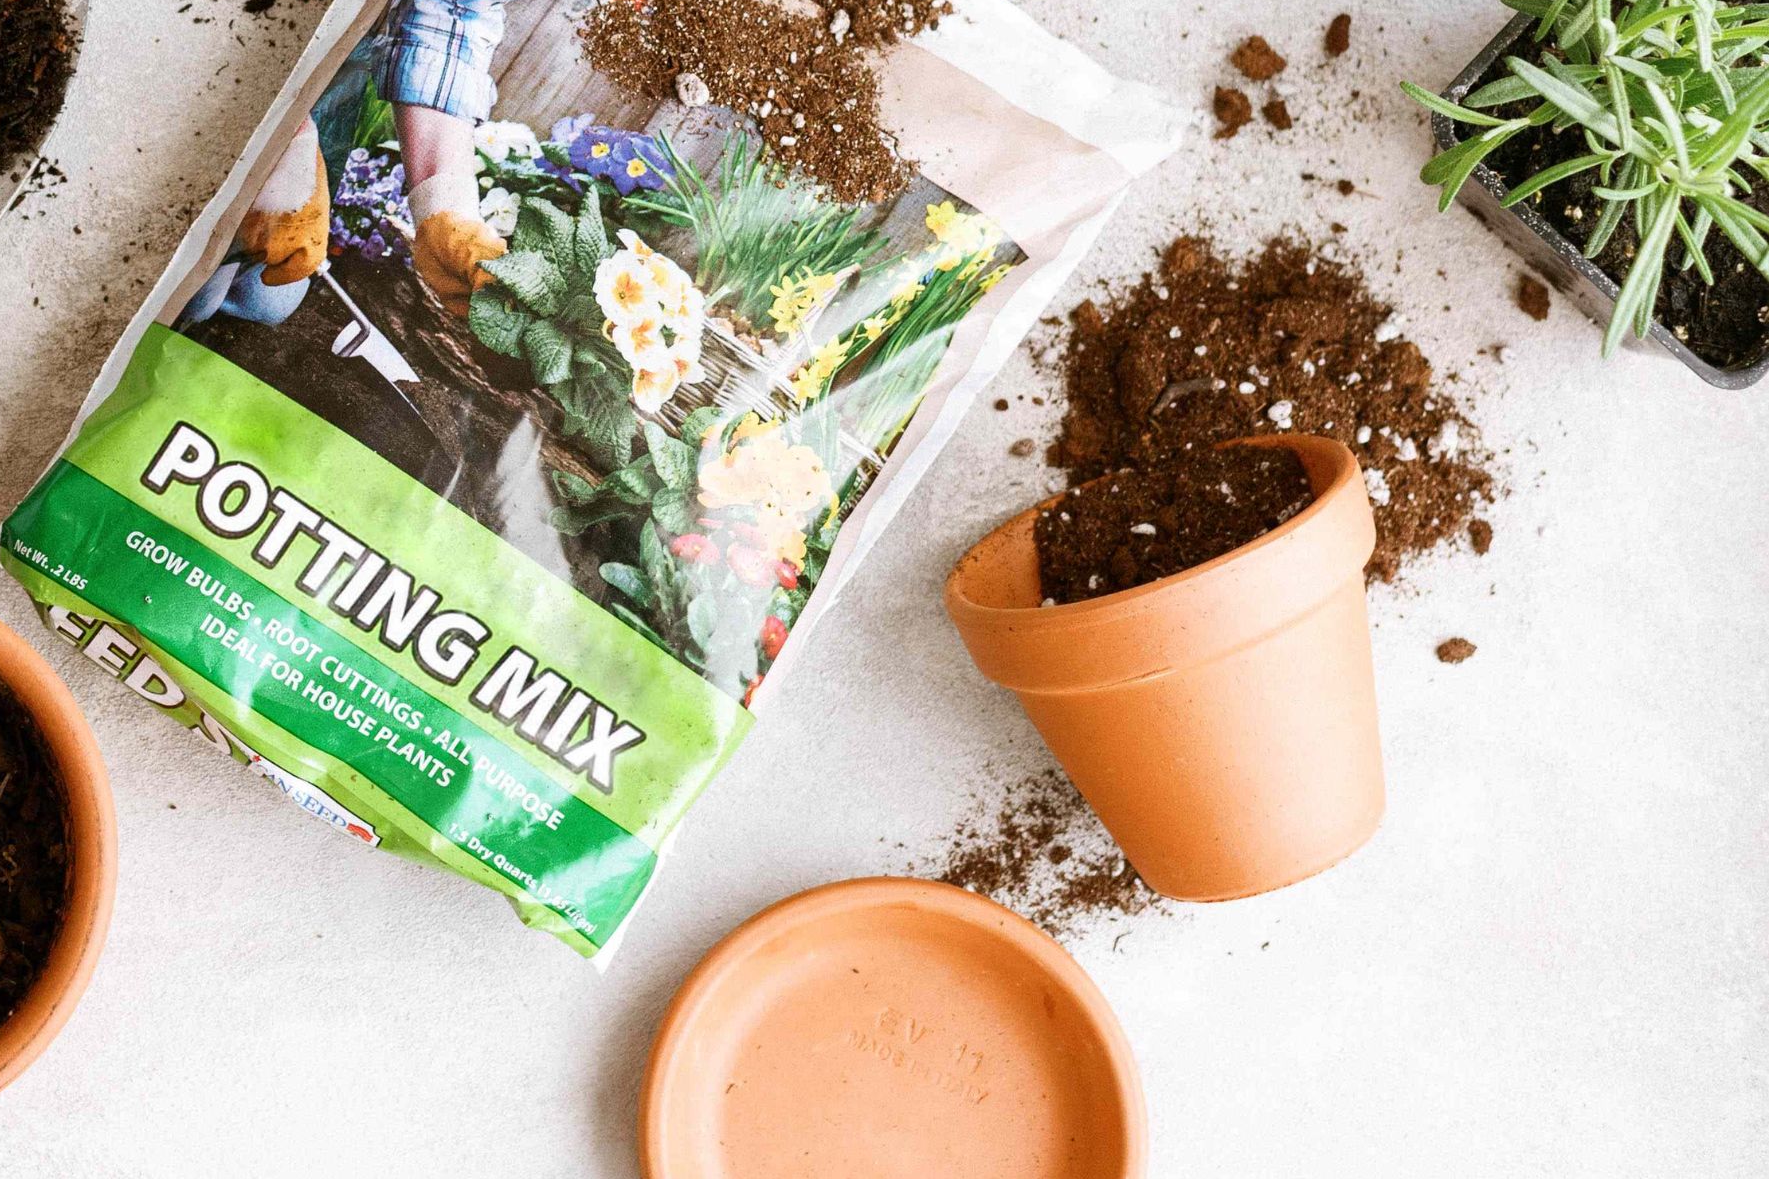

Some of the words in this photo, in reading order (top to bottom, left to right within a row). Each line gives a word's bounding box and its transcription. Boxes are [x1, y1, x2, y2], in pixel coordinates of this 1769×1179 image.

[14, 539, 32, 557] Net
[32, 550, 48, 568] Wt.
[50, 564, 64, 576] .2
[63, 570, 87, 589] LBS
[141, 421, 489, 686] POTTING
[468, 647, 646, 792] MIX
[126, 531, 189, 575] GROW
[186, 567, 254, 620] BULBS
[263, 618, 322, 662] ROOT
[320, 656, 424, 729] CUTTINGS
[432, 729, 478, 765] ALL
[473, 754, 563, 828] PURPOSE
[200, 614, 261, 665] IDEAL
[256, 650, 303, 690] FOR
[302, 680, 377, 736] HOUSE
[374, 726, 454, 786] PLANTS
[467, 836, 493, 859] Dry
[493, 854, 538, 892] Quarts
